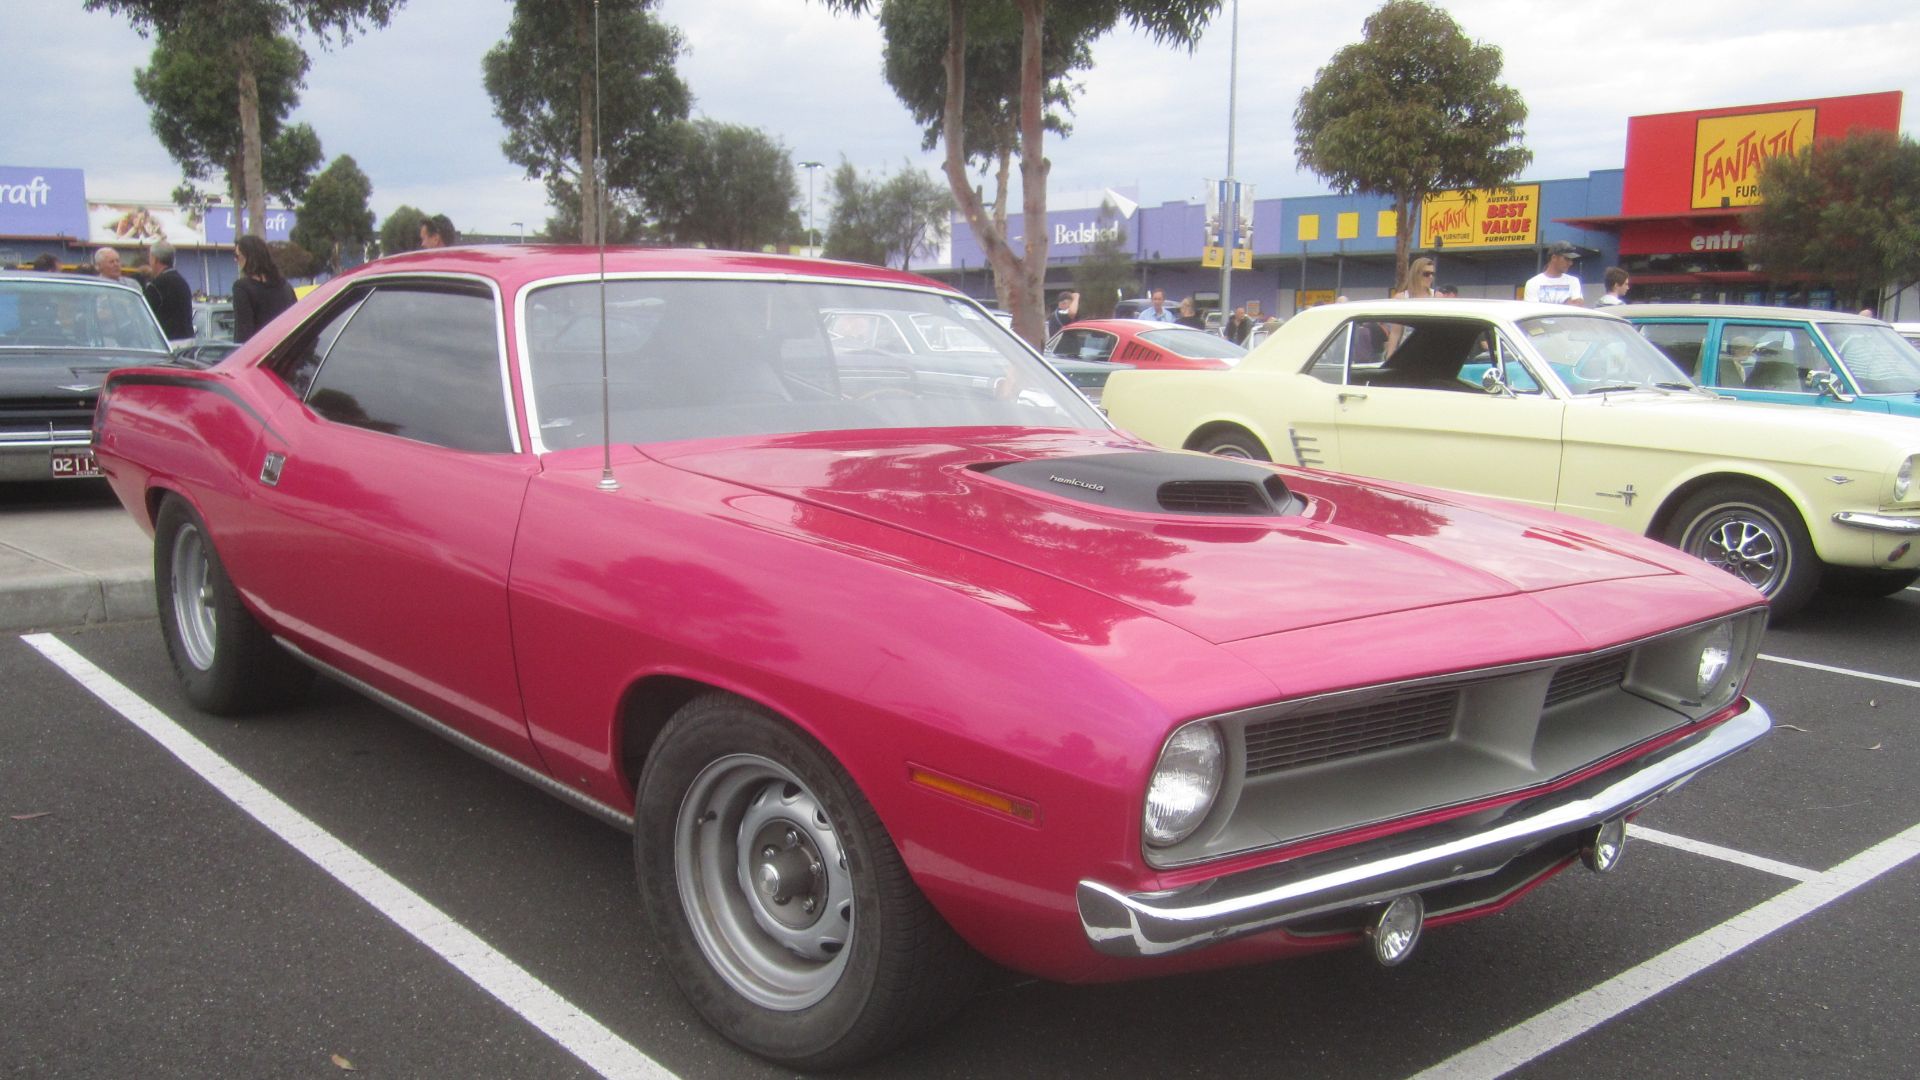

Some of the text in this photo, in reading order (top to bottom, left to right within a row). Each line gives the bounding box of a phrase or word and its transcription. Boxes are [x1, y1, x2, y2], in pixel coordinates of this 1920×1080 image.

[1486, 194, 1529, 203] AUSTRALIA'S
[1735, 184, 1761, 198] FUR
[1487, 203, 1527, 218] BEST
[1429, 203, 1470, 240] FANTASTIC
[1482, 219, 1531, 234] VALUE
[1055, 220, 1119, 245] Bedshed
[1049, 474, 1104, 491] hemicuda
